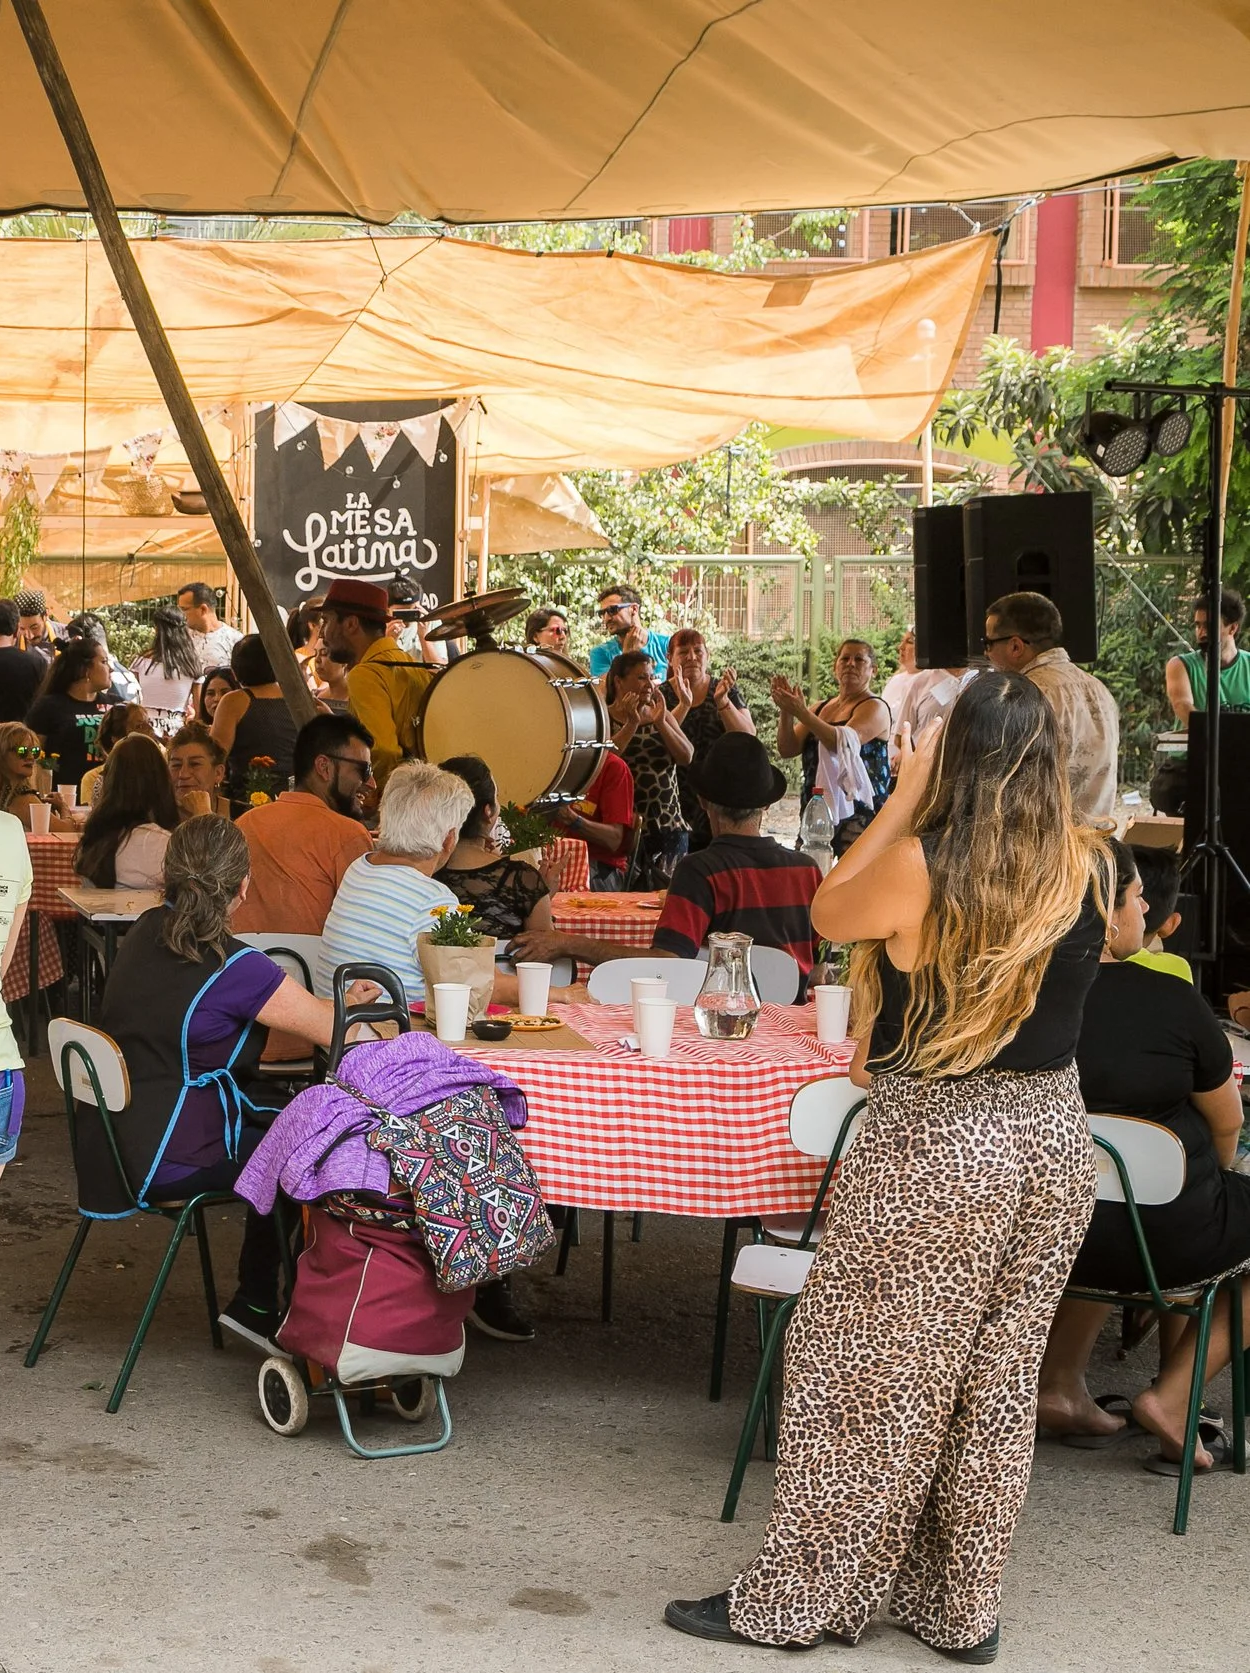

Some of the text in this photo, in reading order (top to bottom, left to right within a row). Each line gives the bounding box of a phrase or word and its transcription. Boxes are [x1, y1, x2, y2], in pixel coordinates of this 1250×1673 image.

[345, 492, 372, 510] LA
[329, 507, 418, 537] MESA
[282, 512, 438, 592] Latina
[75, 714, 104, 727] JUS
